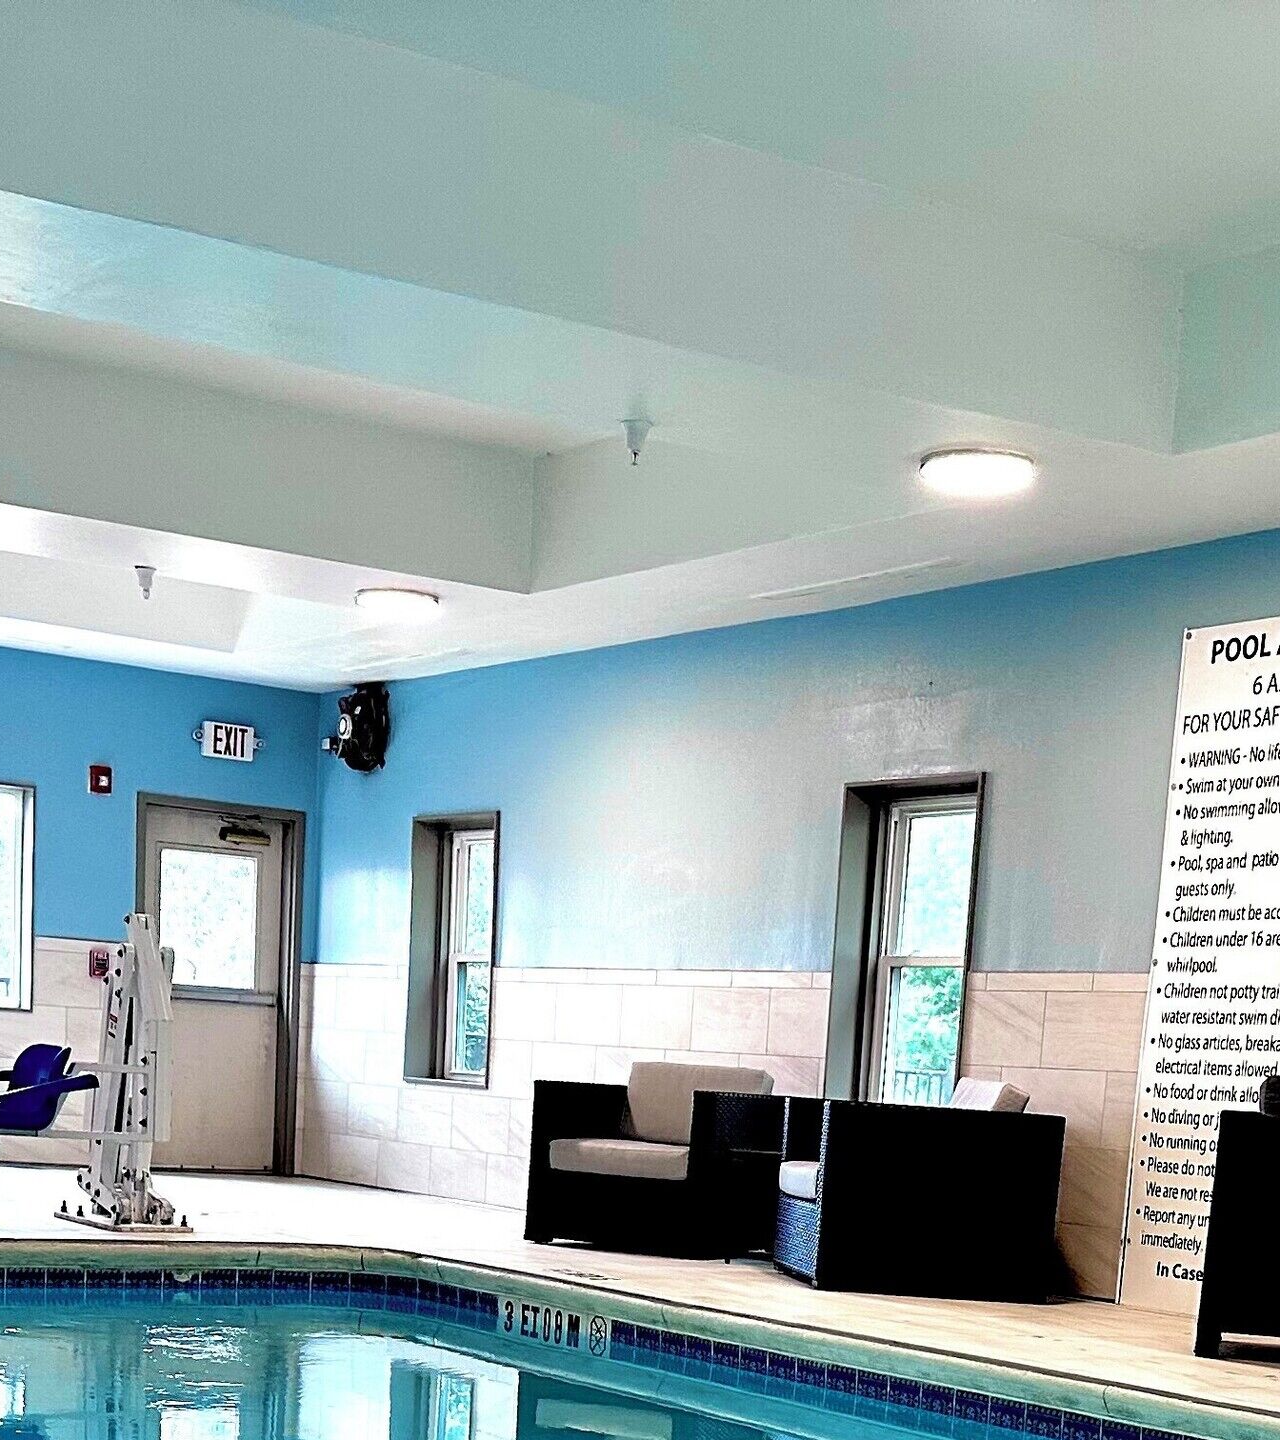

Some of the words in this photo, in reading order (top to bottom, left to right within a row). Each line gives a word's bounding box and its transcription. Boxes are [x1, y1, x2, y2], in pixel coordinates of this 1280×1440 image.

[1211, 633, 1270, 664] POOL
[1253, 676, 1262, 694] 6
[1183, 714, 1209, 735] FOR
[1213, 709, 1250, 731] YOUR
[213, 725, 248, 758] EXIT
[1189, 748, 1240, 768] WARNING
[1250, 746, 1265, 763] No
[1186, 777, 1213, 794] Swim
[1217, 777, 1227, 791] at
[1229, 774, 1253, 795] your
[1256, 773, 1279, 788] own
[1184, 805, 1198, 819] No
[1201, 801, 1255, 820] swimming
[1181, 831, 1189, 845] &
[1191, 828, 1233, 848] lighting.
[1178, 855, 1204, 872] Pool,
[1206, 857, 1223, 873] spa
[1227, 856, 1246, 869] and
[1252, 852, 1278, 871] patio
[1176, 882, 1209, 900] guests
[1211, 880, 1236, 898] only.
[1173, 906, 1216, 922] Children
[1219, 907, 1245, 921] must
[1248, 905, 1261, 921] be
[1170, 931, 1213, 948] Children
[1216, 931, 1247, 947] under
[1251, 931, 1263, 946] 16
[1167, 958, 1217, 975] whirlpool.
[1164, 983, 1207, 1000] Children
[1210, 986, 1227, 1000] not
[1230, 985, 1259, 1002] potty
[1161, 1010, 1190, 1024] water
[1192, 1010, 1236, 1025] resistant
[1239, 1010, 1267, 1025] swim
[1158, 1037, 1173, 1049] No
[1175, 1038, 1200, 1051] glass
[1203, 1037, 1242, 1051] articles,
[1156, 1061, 1201, 1075] electrical
[1204, 1062, 1232, 1077] items
[1153, 1083, 1168, 1099] No
[1170, 1084, 1194, 1101] food
[1197, 1087, 1208, 1101] or
[1210, 1084, 1237, 1102] drink
[1240, 1084, 1260, 1103] allo
[1151, 1108, 1166, 1124] No
[1169, 1109, 1200, 1130] diving
[1202, 1114, 1214, 1126] or
[1149, 1133, 1164, 1149] No
[1166, 1135, 1207, 1155] running
[1147, 1157, 1180, 1174] Please
[1182, 1160, 1194, 1175] do
[1197, 1162, 1216, 1177] not
[1146, 1181, 1161, 1197] We
[1162, 1185, 1178, 1199] are
[1181, 1185, 1197, 1200] not
[1143, 1206, 1176, 1224] Report
[1178, 1210, 1195, 1228] any
[1141, 1230, 1203, 1254] immediately.
[1157, 1261, 1169, 1277] In
[1173, 1264, 1204, 1282] Case
